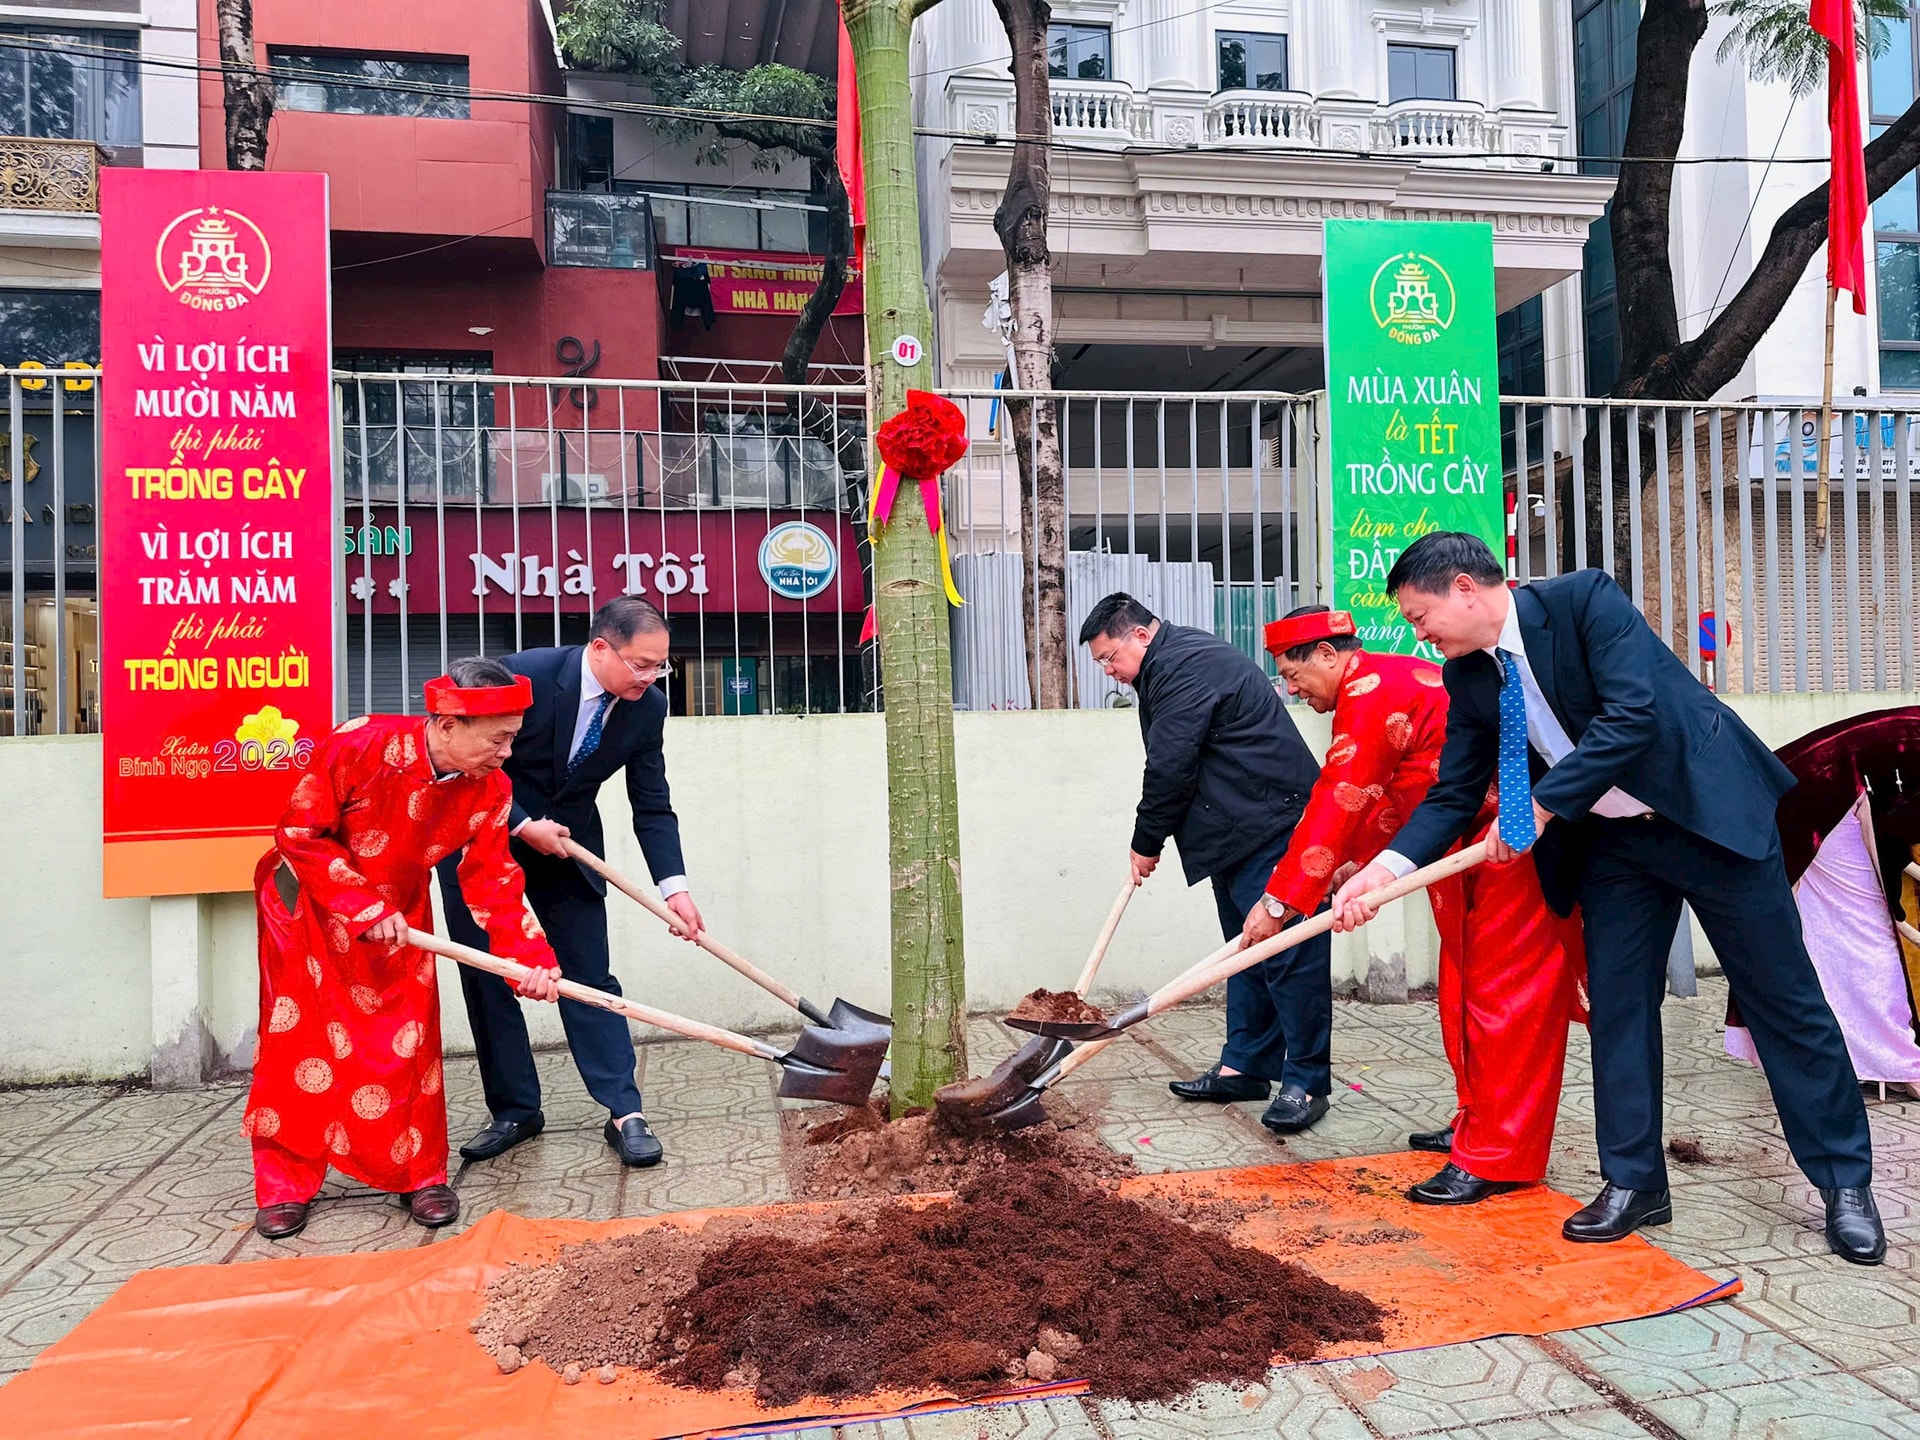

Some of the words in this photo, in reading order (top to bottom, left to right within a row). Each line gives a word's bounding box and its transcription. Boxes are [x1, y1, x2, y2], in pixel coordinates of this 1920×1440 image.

[732, 287, 769, 310] NHÀ
[137, 335, 165, 373] VÌ
[176, 343, 226, 381] LỢI
[236, 336, 290, 373] ÍCH
[897, 341, 917, 360] 01
[135, 380, 220, 418] MƯỜI
[230, 383, 297, 419] NĂM
[1347, 367, 1408, 404] MÙA
[1413, 369, 1482, 405] XUÂN
[170, 424, 203, 451] thì
[203, 424, 265, 461] phải
[1386, 408, 1409, 441] là
[1414, 408, 1459, 454] TẾT
[125, 449, 233, 500] TRỒNG
[243, 456, 307, 500] CÂY
[1345, 447, 1436, 495] TRỒNG
[1443, 455, 1489, 495] CÂY
[1349, 508, 1397, 538] làm
[1403, 507, 1441, 537] cho
[140, 523, 168, 560] VÌ
[179, 528, 230, 568] LỢI
[240, 522, 294, 560] ÍCH
[138, 569, 221, 606] TRĂM
[231, 569, 297, 604] NĂM
[468, 549, 597, 597] Nhà
[612, 551, 710, 596] Tôi
[171, 612, 206, 641] thì
[204, 612, 268, 649] phải
[1356, 617, 1407, 655] càng
[124, 640, 218, 691] TRỒNG
[226, 644, 311, 690] NGƯỜI
[160, 736, 211, 757] Xuân
[212, 738, 315, 773] 2026
[170, 756, 211, 779] Ngọ
